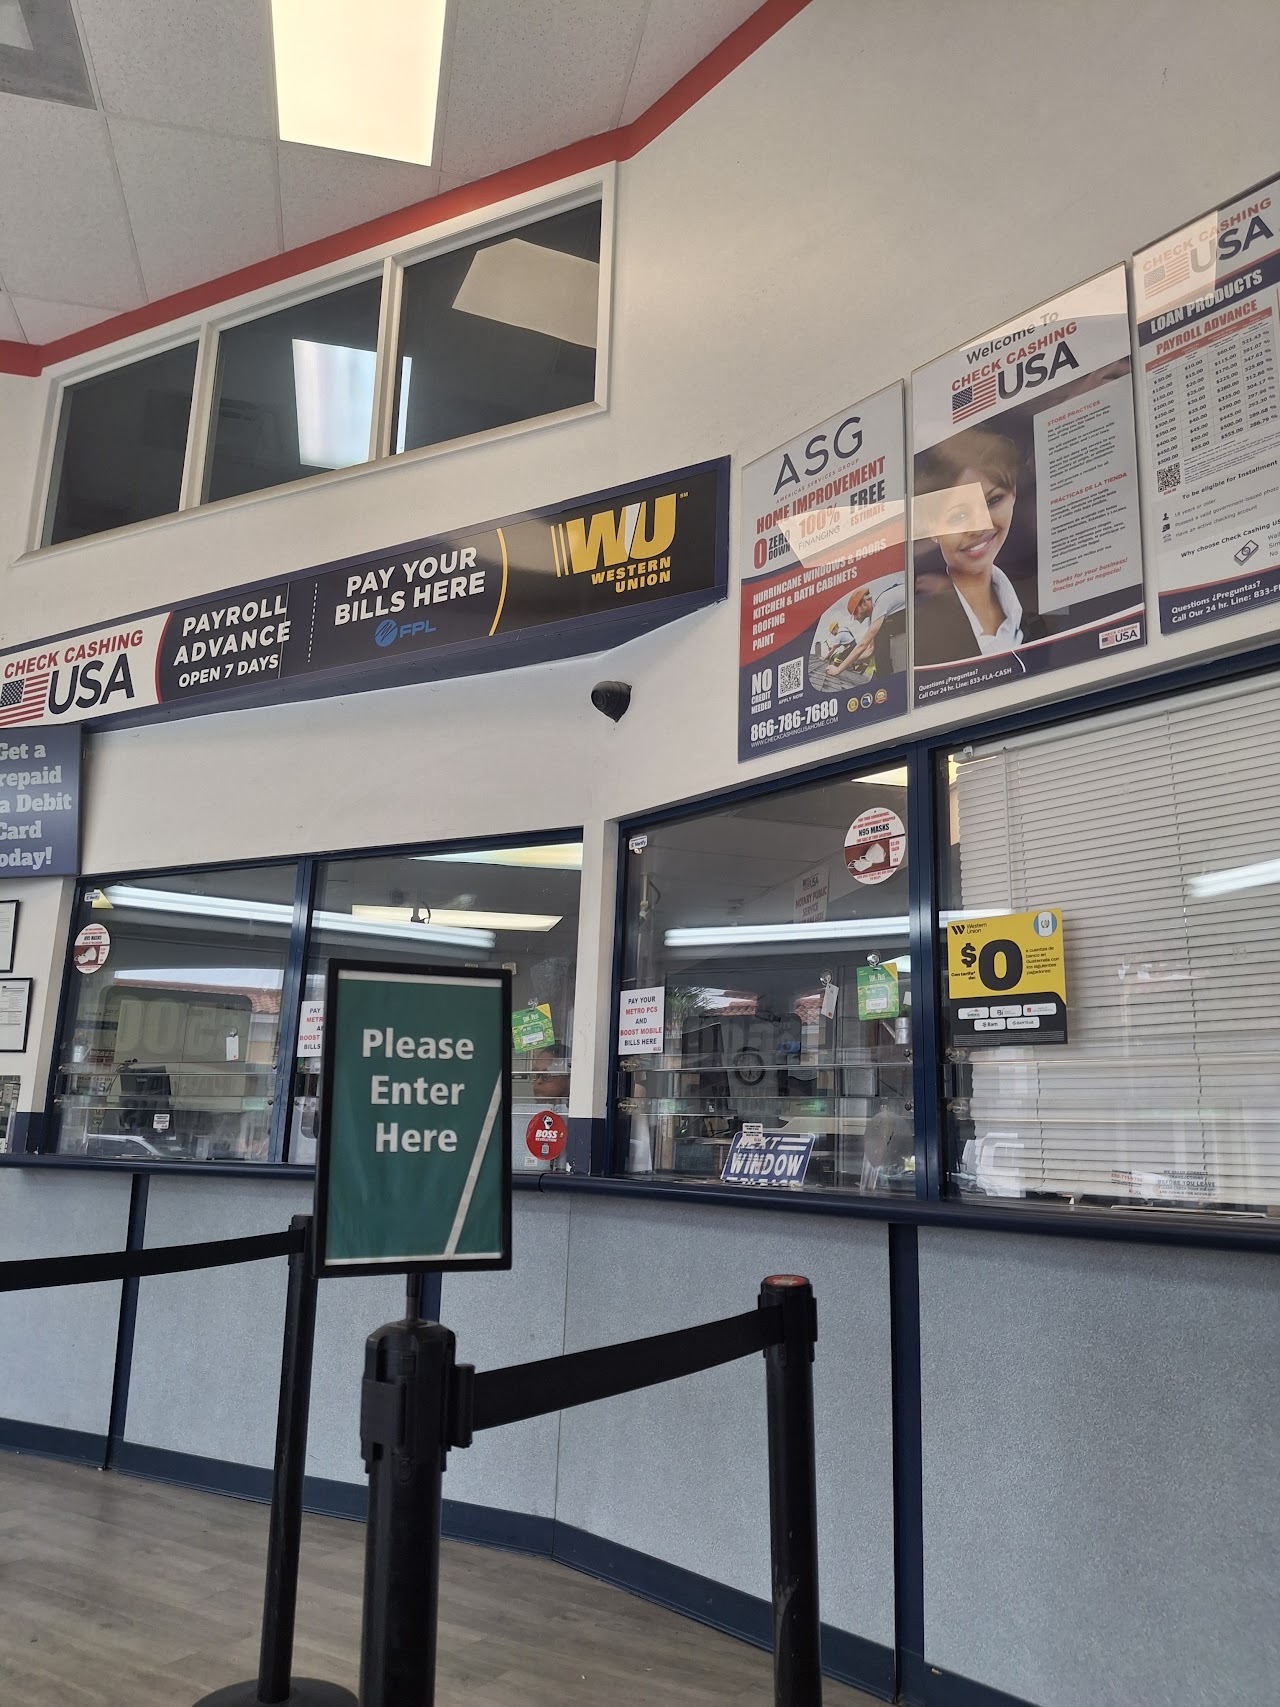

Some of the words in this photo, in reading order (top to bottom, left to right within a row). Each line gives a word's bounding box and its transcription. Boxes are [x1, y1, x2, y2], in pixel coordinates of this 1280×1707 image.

[1143, 238, 1193, 272] CHECK
[1199, 197, 1271, 242] CASHING
[1191, 215, 1274, 273] USA
[1151, 306, 1184, 334] LOAN
[1187, 269, 1262, 317] PRODUCTS
[966, 325, 1035, 365] Welcome
[1040, 312, 1058, 327] To
[1156, 325, 1202, 355] PAYROLL
[1204, 299, 1257, 333] ADVANCE
[952, 358, 1001, 392] CHECK
[1006, 321, 1077, 365] CASHING
[998, 340, 1080, 400] USA
[1048, 415, 1066, 426] STORE
[1068, 400, 1100, 418] PRACTICES
[773, 417, 862, 496] ASG
[776, 486, 805, 503] AMERICAS
[808, 471, 835, 488] SERVICES
[838, 458, 859, 472] GROUP
[1094, 481, 1102, 489] LA
[1104, 472, 1127, 484] TIENDA
[1201, 480, 1224, 493] eligible
[1238, 460, 1277, 478] Installment
[757, 504, 789, 534] HOME
[793, 456, 885, 516] IMPROVEMENT
[799, 502, 840, 538] 100%
[850, 479, 885, 514] FREE
[1175, 518, 1193, 527] Possess
[1213, 492, 1262, 514] government-issued
[1264, 486, 1279, 496] photo
[1182, 506, 1195, 515] years
[799, 525, 840, 550] FINANCING
[851, 503, 885, 526] ESTIMATE
[1214, 513, 1235, 524] checking
[1237, 505, 1257, 515] account
[563, 492, 677, 575] WU
[754, 538, 767, 569] 0
[769, 530, 790, 550] ZERO
[1181, 550, 1195, 558] Why
[1197, 541, 1219, 552] choose
[1222, 533, 1241, 543] Check
[1243, 523, 1270, 536] Cashing
[769, 543, 790, 560] DOWN
[346, 567, 394, 598] PAY
[402, 547, 477, 584] YOUR
[590, 556, 671, 585] WESTERN
[615, 570, 671, 594] UNION
[753, 575, 801, 606] HURRINCANE
[803, 556, 845, 584] WINDOWS
[848, 554, 854, 564] &
[856, 538, 886, 561] DOORS
[1053, 573, 1073, 585] Thanks
[1084, 565, 1098, 576] your
[1100, 557, 1128, 571] business!
[1053, 583, 1074, 593] Gracias
[1095, 567, 1121, 579] negocio!
[334, 591, 405, 626] BILLS
[412, 571, 486, 608] HERE
[753, 595, 785, 620] KITCHEN
[787, 596, 792, 606] &
[794, 583, 814, 603] BATH
[816, 566, 857, 594] CABINETS
[1172, 596, 1210, 614] Questions
[1212, 580, 1261, 602] ¿Preguntas?
[1172, 613, 1186, 623] Call
[1189, 609, 1203, 618] Our
[1206, 604, 1216, 614] 24
[1218, 600, 1229, 609] hr.
[1231, 594, 1251, 606] Line:
[1254, 583, 1280, 599] 833-F
[182, 595, 287, 637] PAYROLL
[399, 622, 437, 639] FPL
[753, 613, 785, 636] ROOFING
[173, 621, 291, 667] ADVANCE
[753, 633, 774, 651] PAINT
[1116, 630, 1137, 642] USA
[4, 651, 59, 679] CHECK
[63, 629, 144, 664] CASHING
[48, 652, 135, 715] USA
[178, 669, 220, 688] OPEN
[224, 664, 234, 680] 7
[237, 654, 279, 676] DAYS
[752, 669, 772, 695] NO
[919, 680, 947, 691] Questions
[946, 669, 978, 684] ¿Preguntas?
[919, 691, 928, 699] Call
[956, 681, 969, 689] Line:
[970, 668, 1012, 685] 833-FLA-CASH
[751, 701, 771, 714] NEEDED
[752, 691, 771, 704] CREDIT
[751, 698, 838, 741] 866-786-7680
[751, 717, 838, 748] WWW.CHECKCASHINGUSAHOME.COM
[0, 742, 28, 760] Get
[34, 744, 46, 758] a
[0, 765, 62, 790] repaid
[0, 800, 10, 813] a
[16, 792, 72, 812] Debit
[859, 828, 869, 837] N95
[871, 824, 890, 834] MASKS
[0, 846, 52, 870] oday!
[362, 1027, 474, 1060] Please
[370, 1075, 465, 1106] Enter
[375, 1122, 458, 1153] Here
[536, 1130, 558, 1138] BOSS
[730, 1153, 804, 1176] WINDOW
